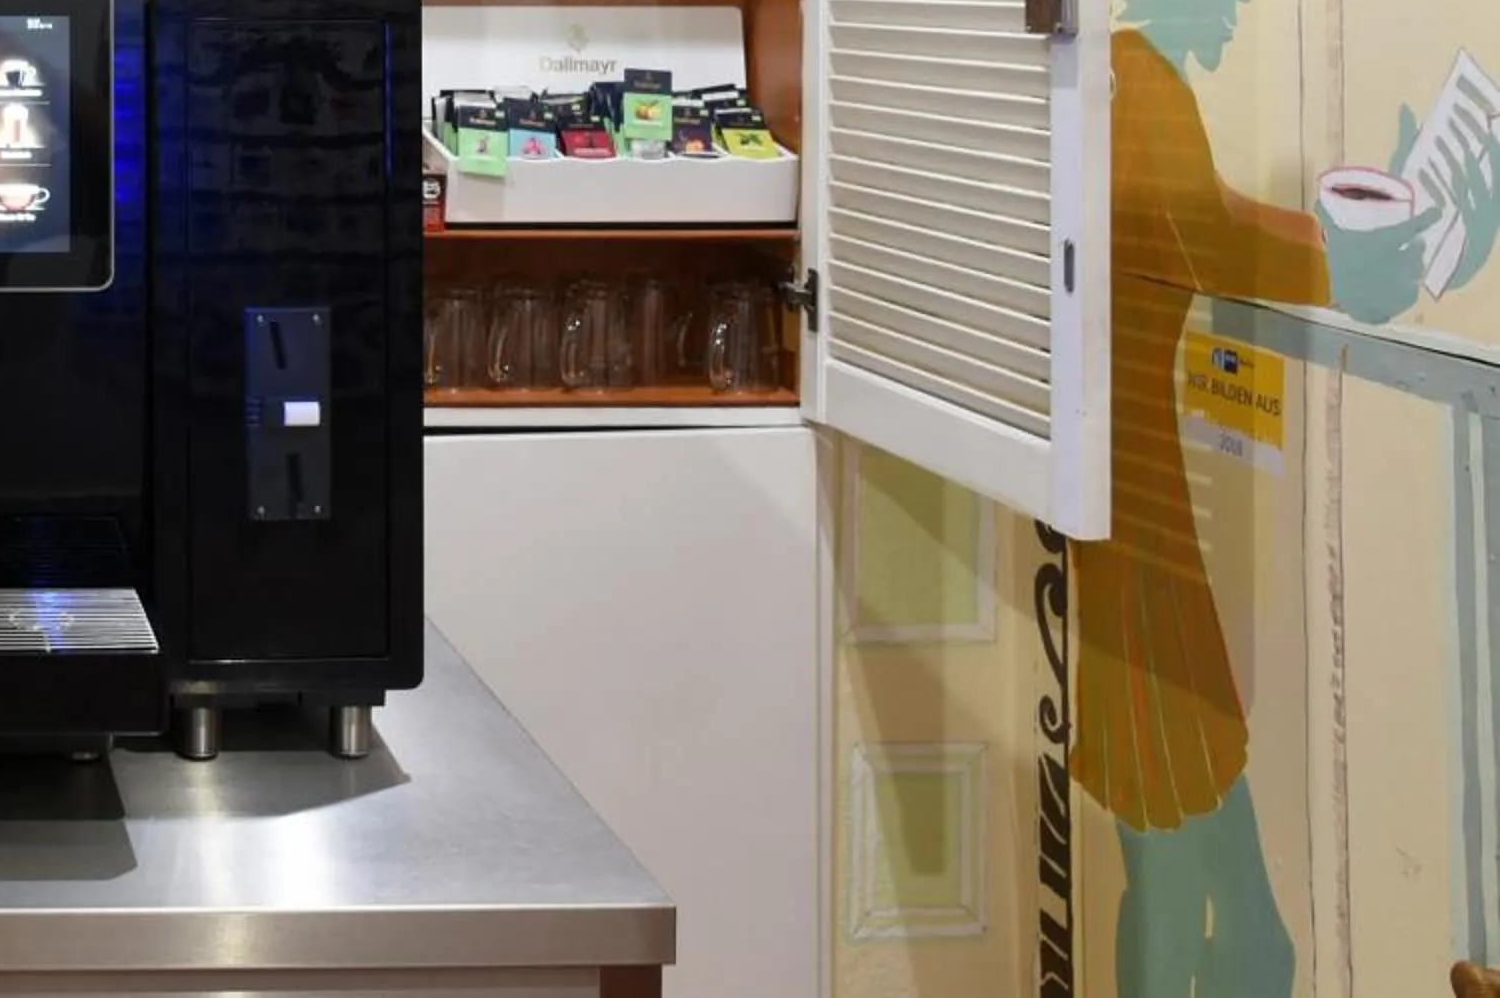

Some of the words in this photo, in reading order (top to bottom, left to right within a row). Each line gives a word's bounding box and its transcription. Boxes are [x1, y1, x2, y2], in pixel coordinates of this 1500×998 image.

[540, 56, 618, 74] Dallmayr
[1211, 377, 1253, 406] BILDEN
[1255, 393, 1281, 417] AUS
